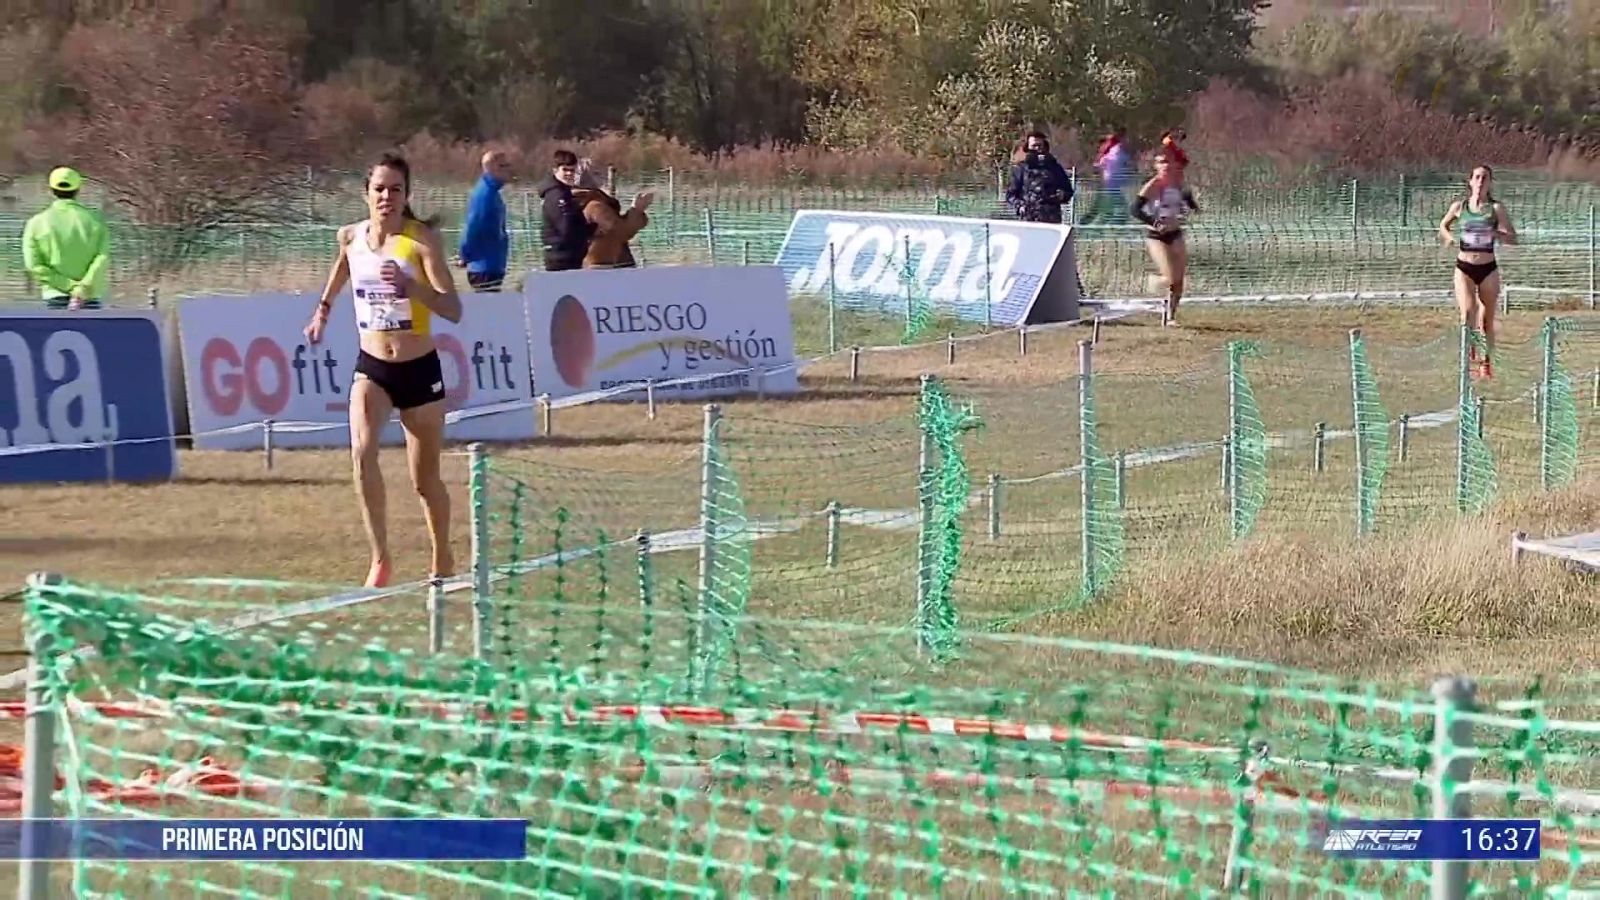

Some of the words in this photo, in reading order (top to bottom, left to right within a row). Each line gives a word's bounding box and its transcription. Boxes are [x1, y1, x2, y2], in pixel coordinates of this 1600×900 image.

[593, 303, 707, 334] RIESGO
[658, 341, 675, 371] y
[684, 329, 777, 370] gestión
